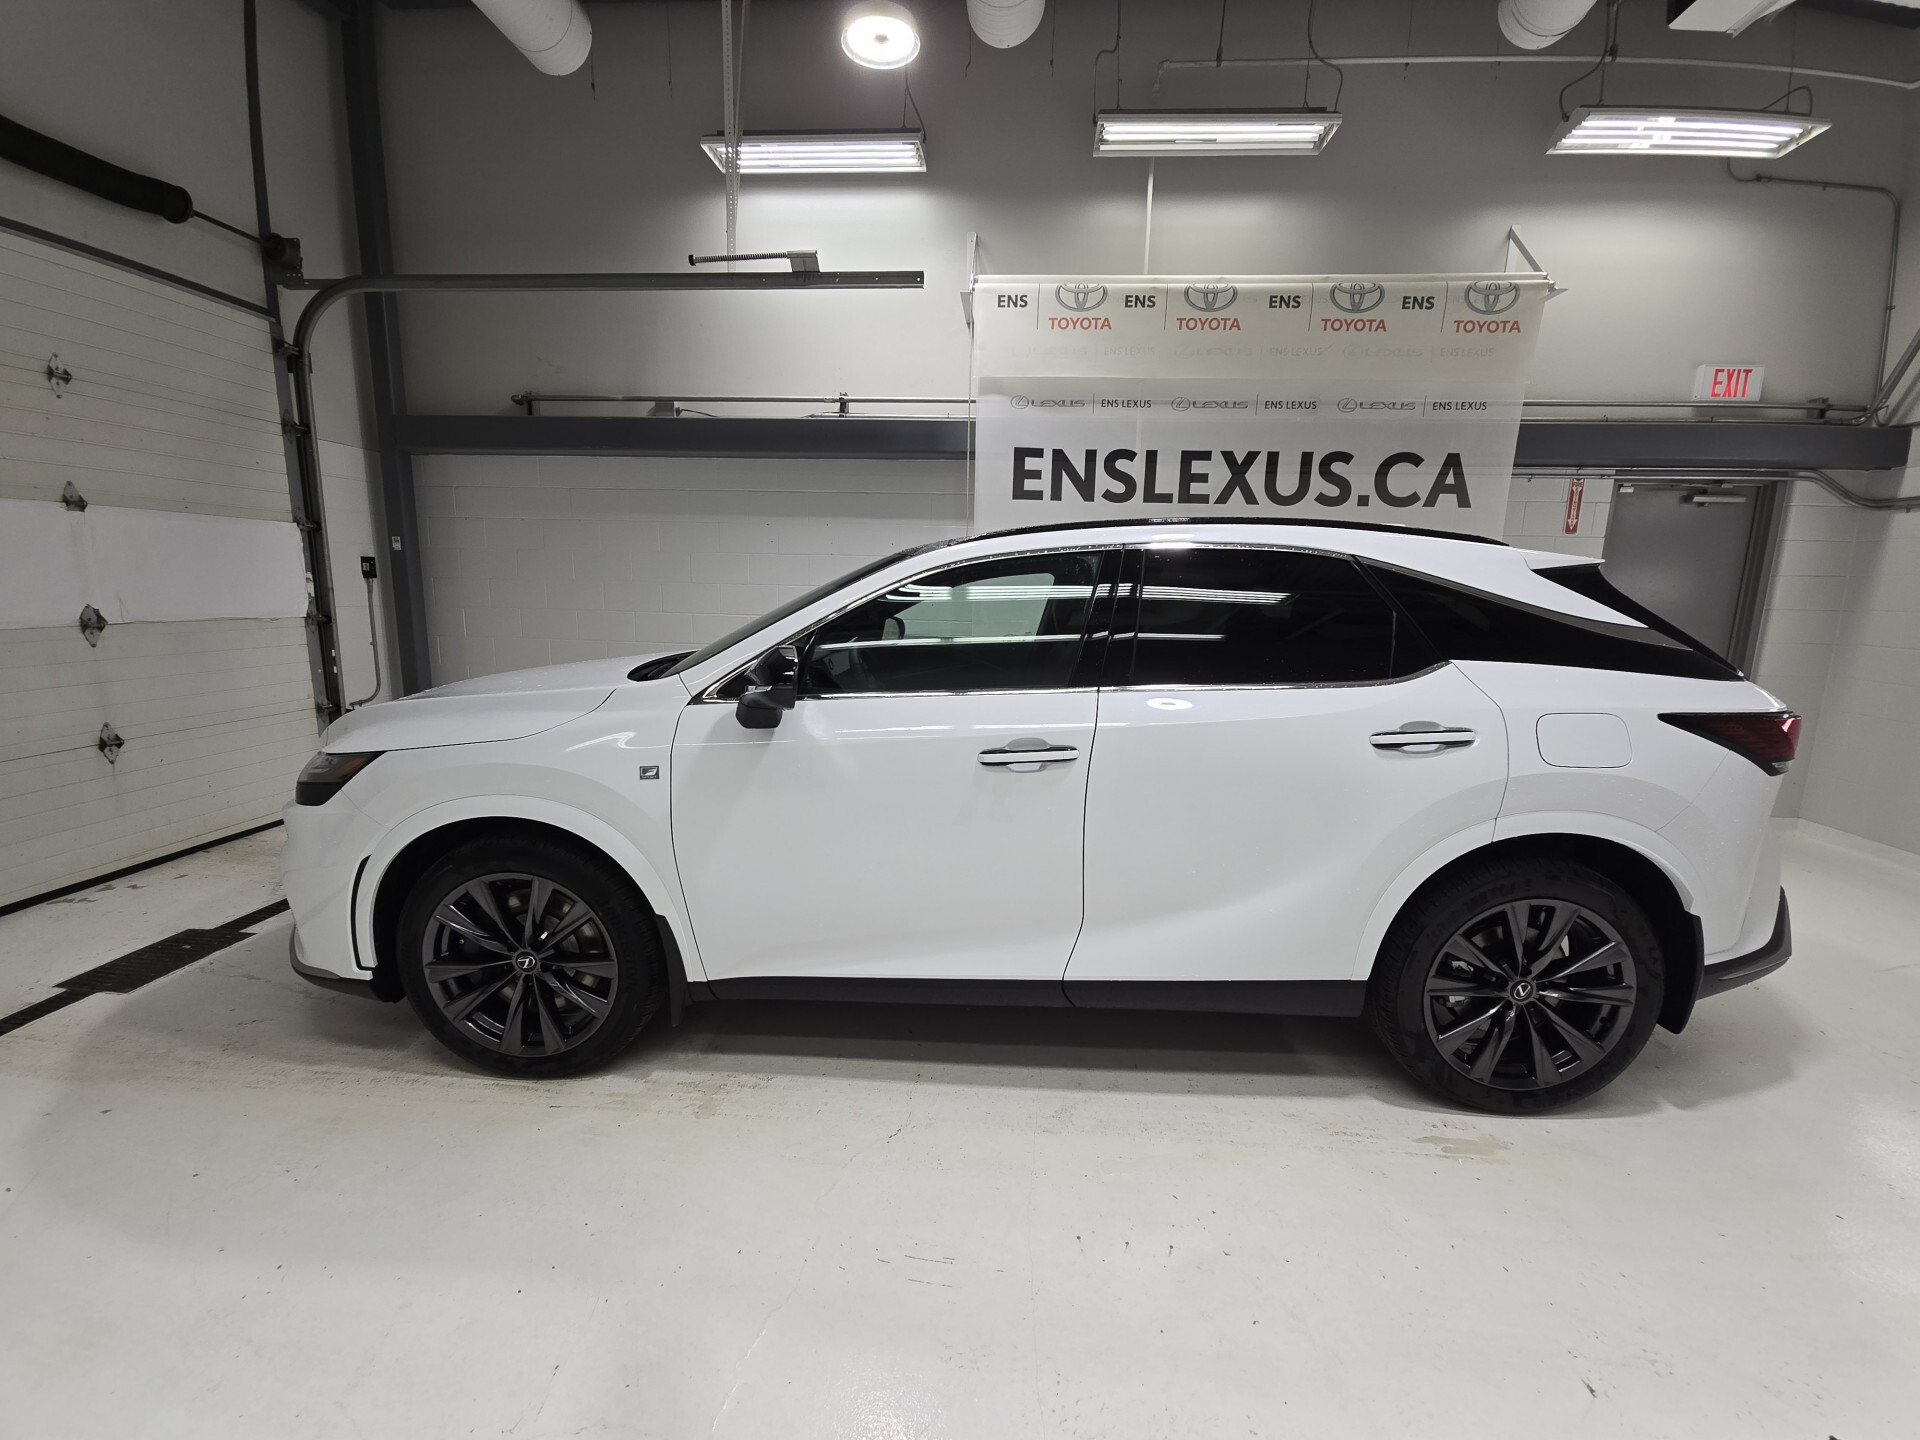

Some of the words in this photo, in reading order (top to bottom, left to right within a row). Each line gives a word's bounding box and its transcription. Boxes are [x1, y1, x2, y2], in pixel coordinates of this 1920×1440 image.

[997, 294, 1028, 309] ENS
[1124, 294, 1156, 309] ENS
[1268, 295, 1302, 310] ENS
[1401, 295, 1435, 311] ENS
[1048, 316, 1112, 331] TOYOTA
[1176, 317, 1241, 331] TOYOTA
[1321, 318, 1387, 333] TOYOTA
[1454, 319, 1521, 334] TOYOTA
[1710, 368, 1753, 398] EXIT
[1101, 399, 1119, 408] ENS
[1121, 399, 1152, 409] LEXUS
[1264, 400, 1283, 410] ENS
[1286, 400, 1318, 410] LEXUS
[1432, 401, 1452, 411] ENS
[1454, 401, 1488, 411] LEXUS
[1012, 446, 1472, 508] ENSLEXUS.CA
